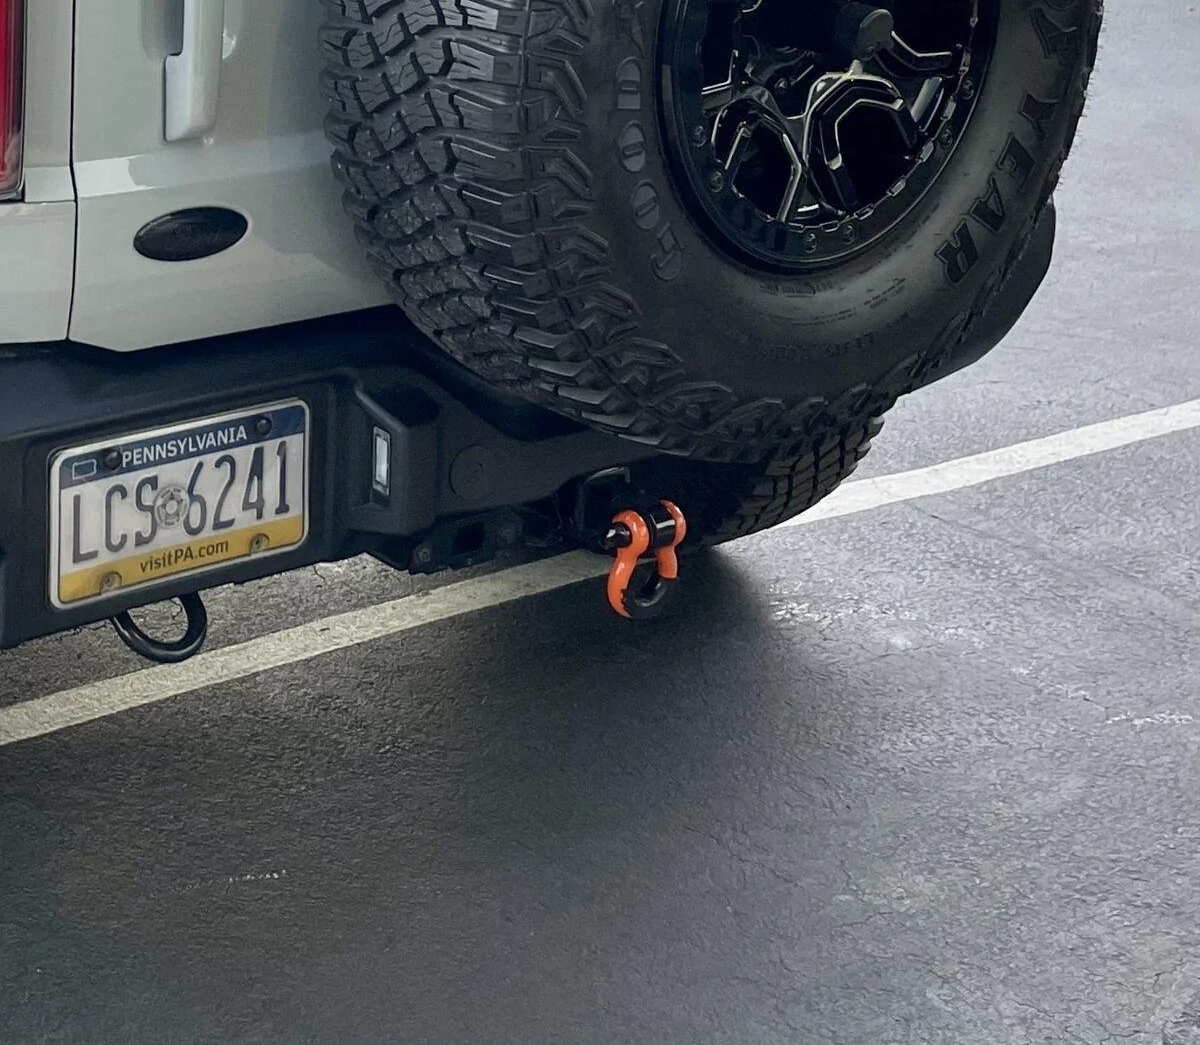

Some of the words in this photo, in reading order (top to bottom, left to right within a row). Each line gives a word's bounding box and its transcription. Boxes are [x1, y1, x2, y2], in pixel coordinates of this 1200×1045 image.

[121, 424, 248, 468] PENNSYLVANIA
[182, 440, 290, 536] 6241
[139, 539, 230, 574] visitPA.com
